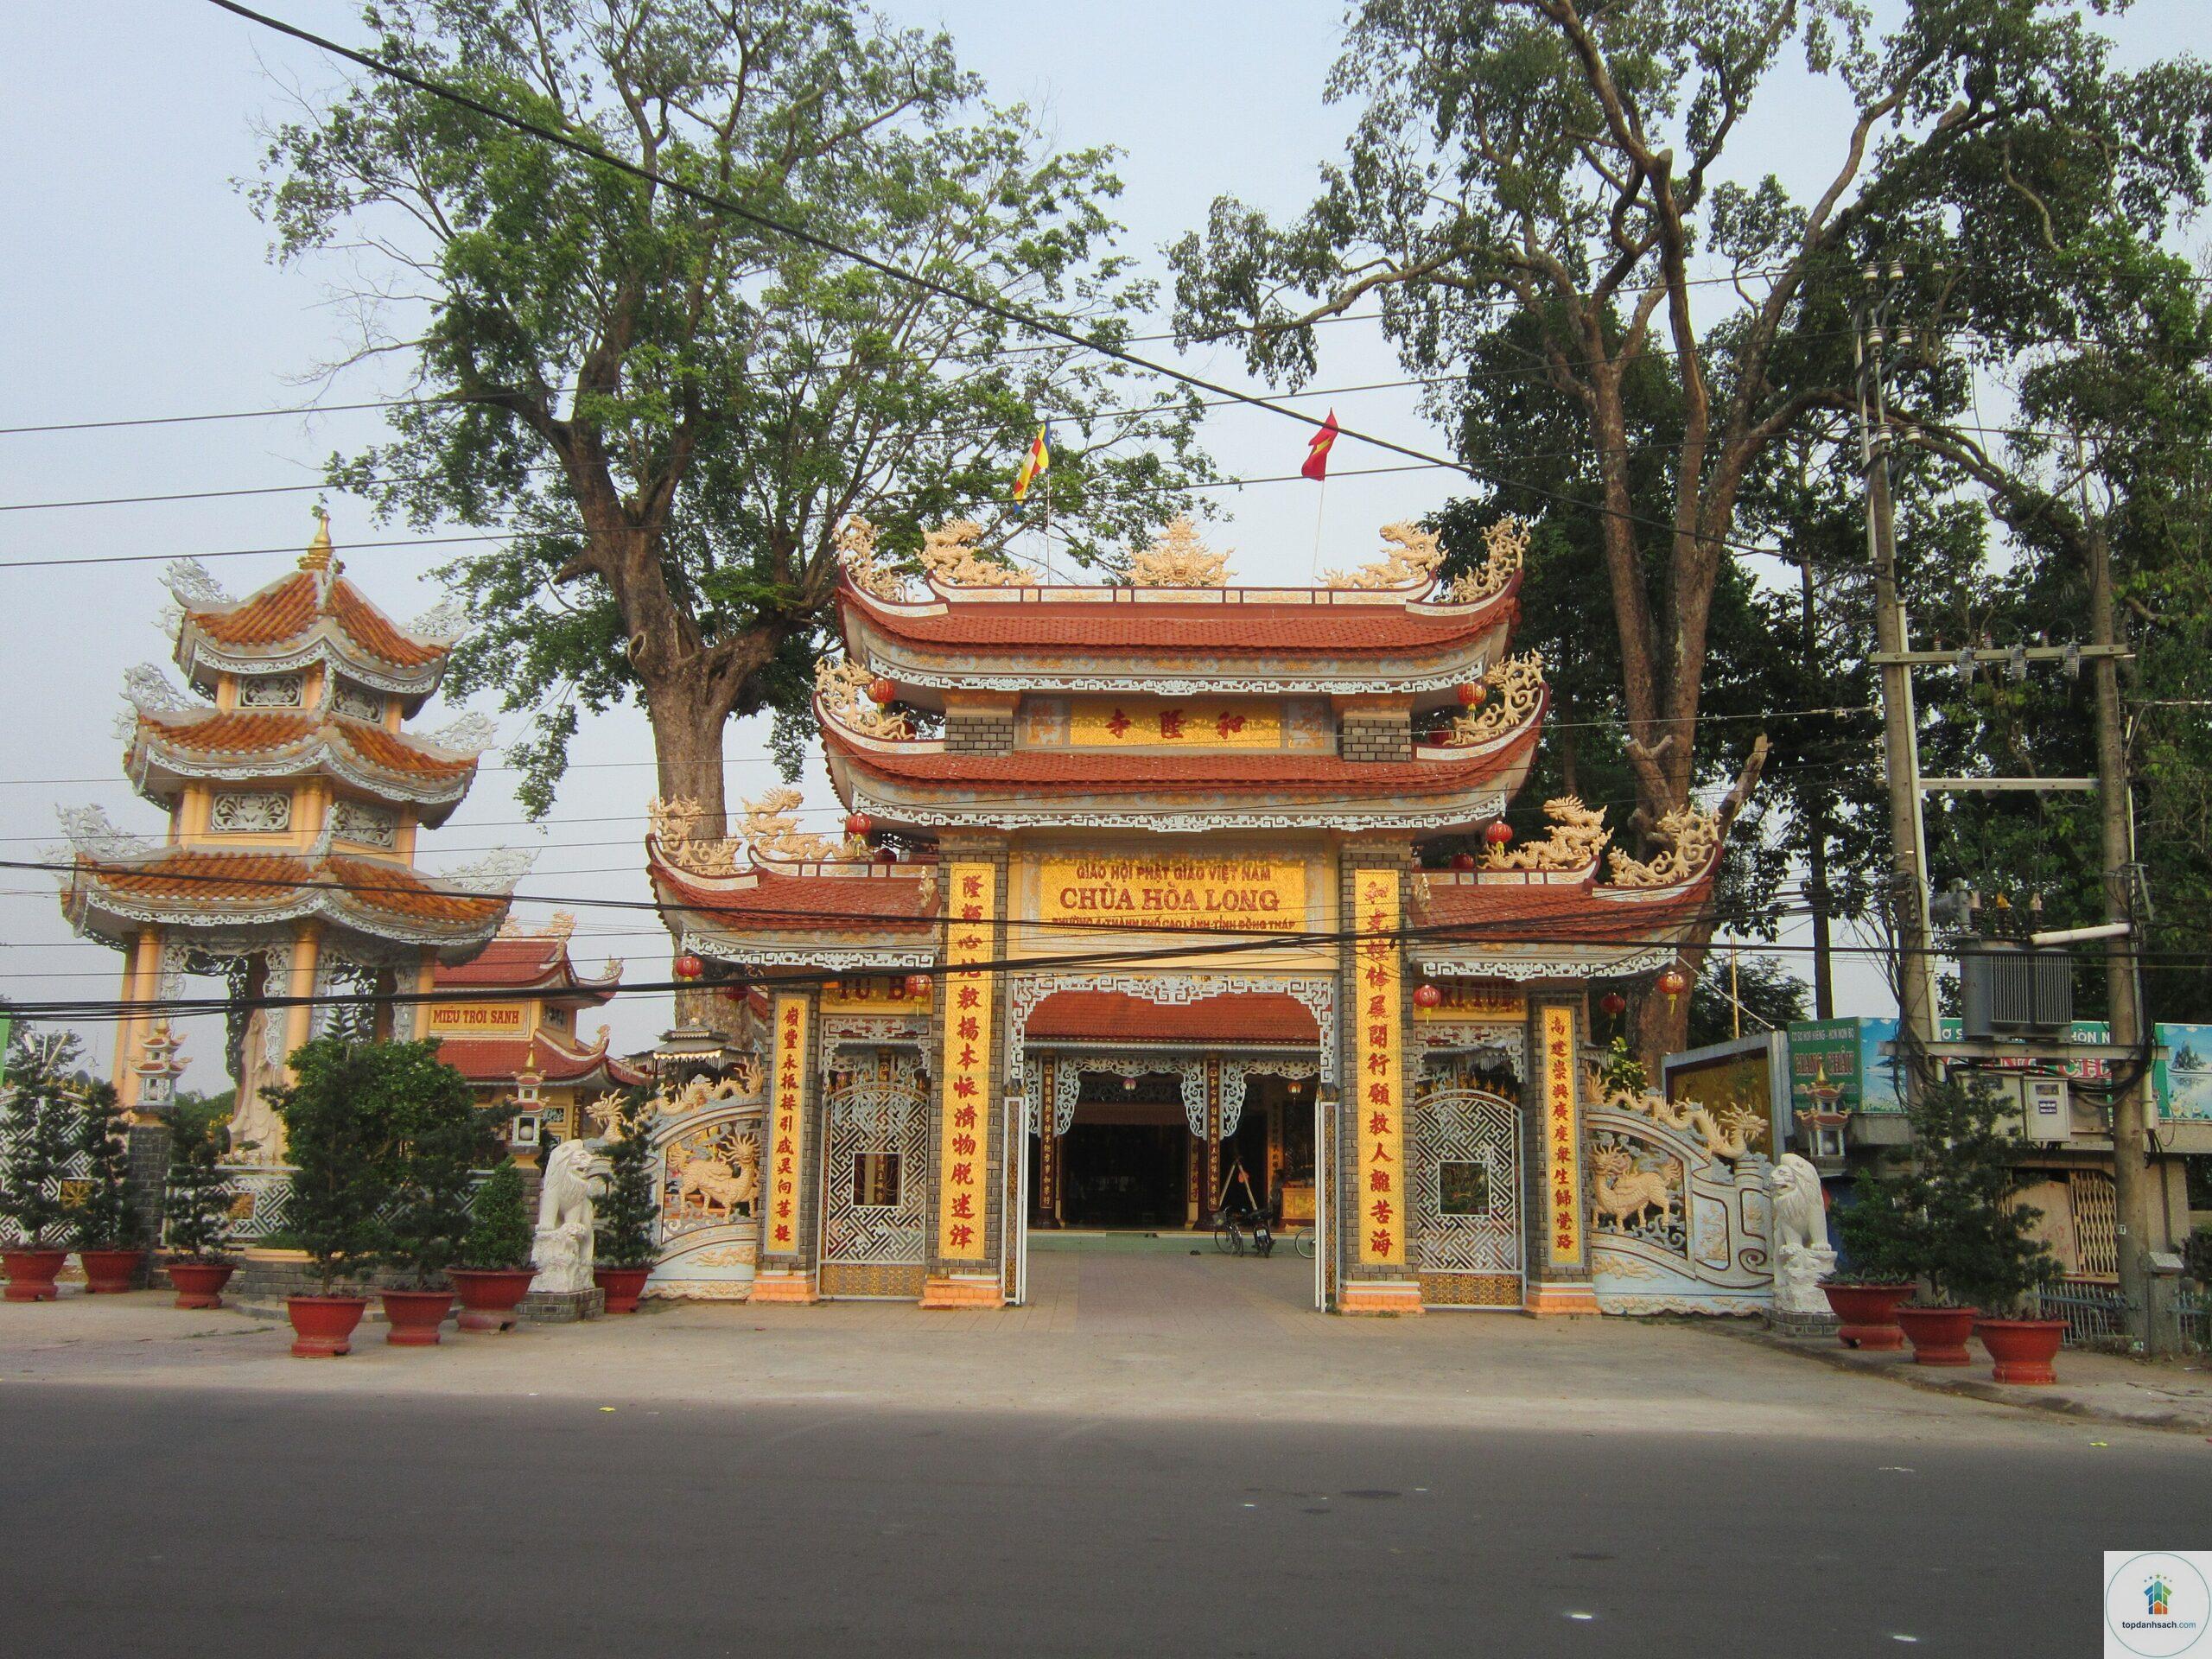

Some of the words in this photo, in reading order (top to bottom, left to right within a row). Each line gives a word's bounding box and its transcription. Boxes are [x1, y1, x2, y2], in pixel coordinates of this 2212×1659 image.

[1077, 861, 1106, 879] GIÁO
[1110, 861, 1133, 882] HỘI
[1136, 861, 1169, 883] PHẬT
[1173, 862, 1205, 880] GIÁO
[1209, 863, 1237, 884] VIỆT
[1242, 865, 1271, 881] NAM
[1059, 881, 1135, 910] CHÙA
[1141, 881, 1199, 911] HÒA
[1205, 888, 1280, 911] LONG
[1162, 918, 1181, 928] CAO
[1238, 917, 1267, 930] ĐỒNG
[1268, 917, 1296, 930] THÁP
[490, 1010, 519, 1024] SANH
